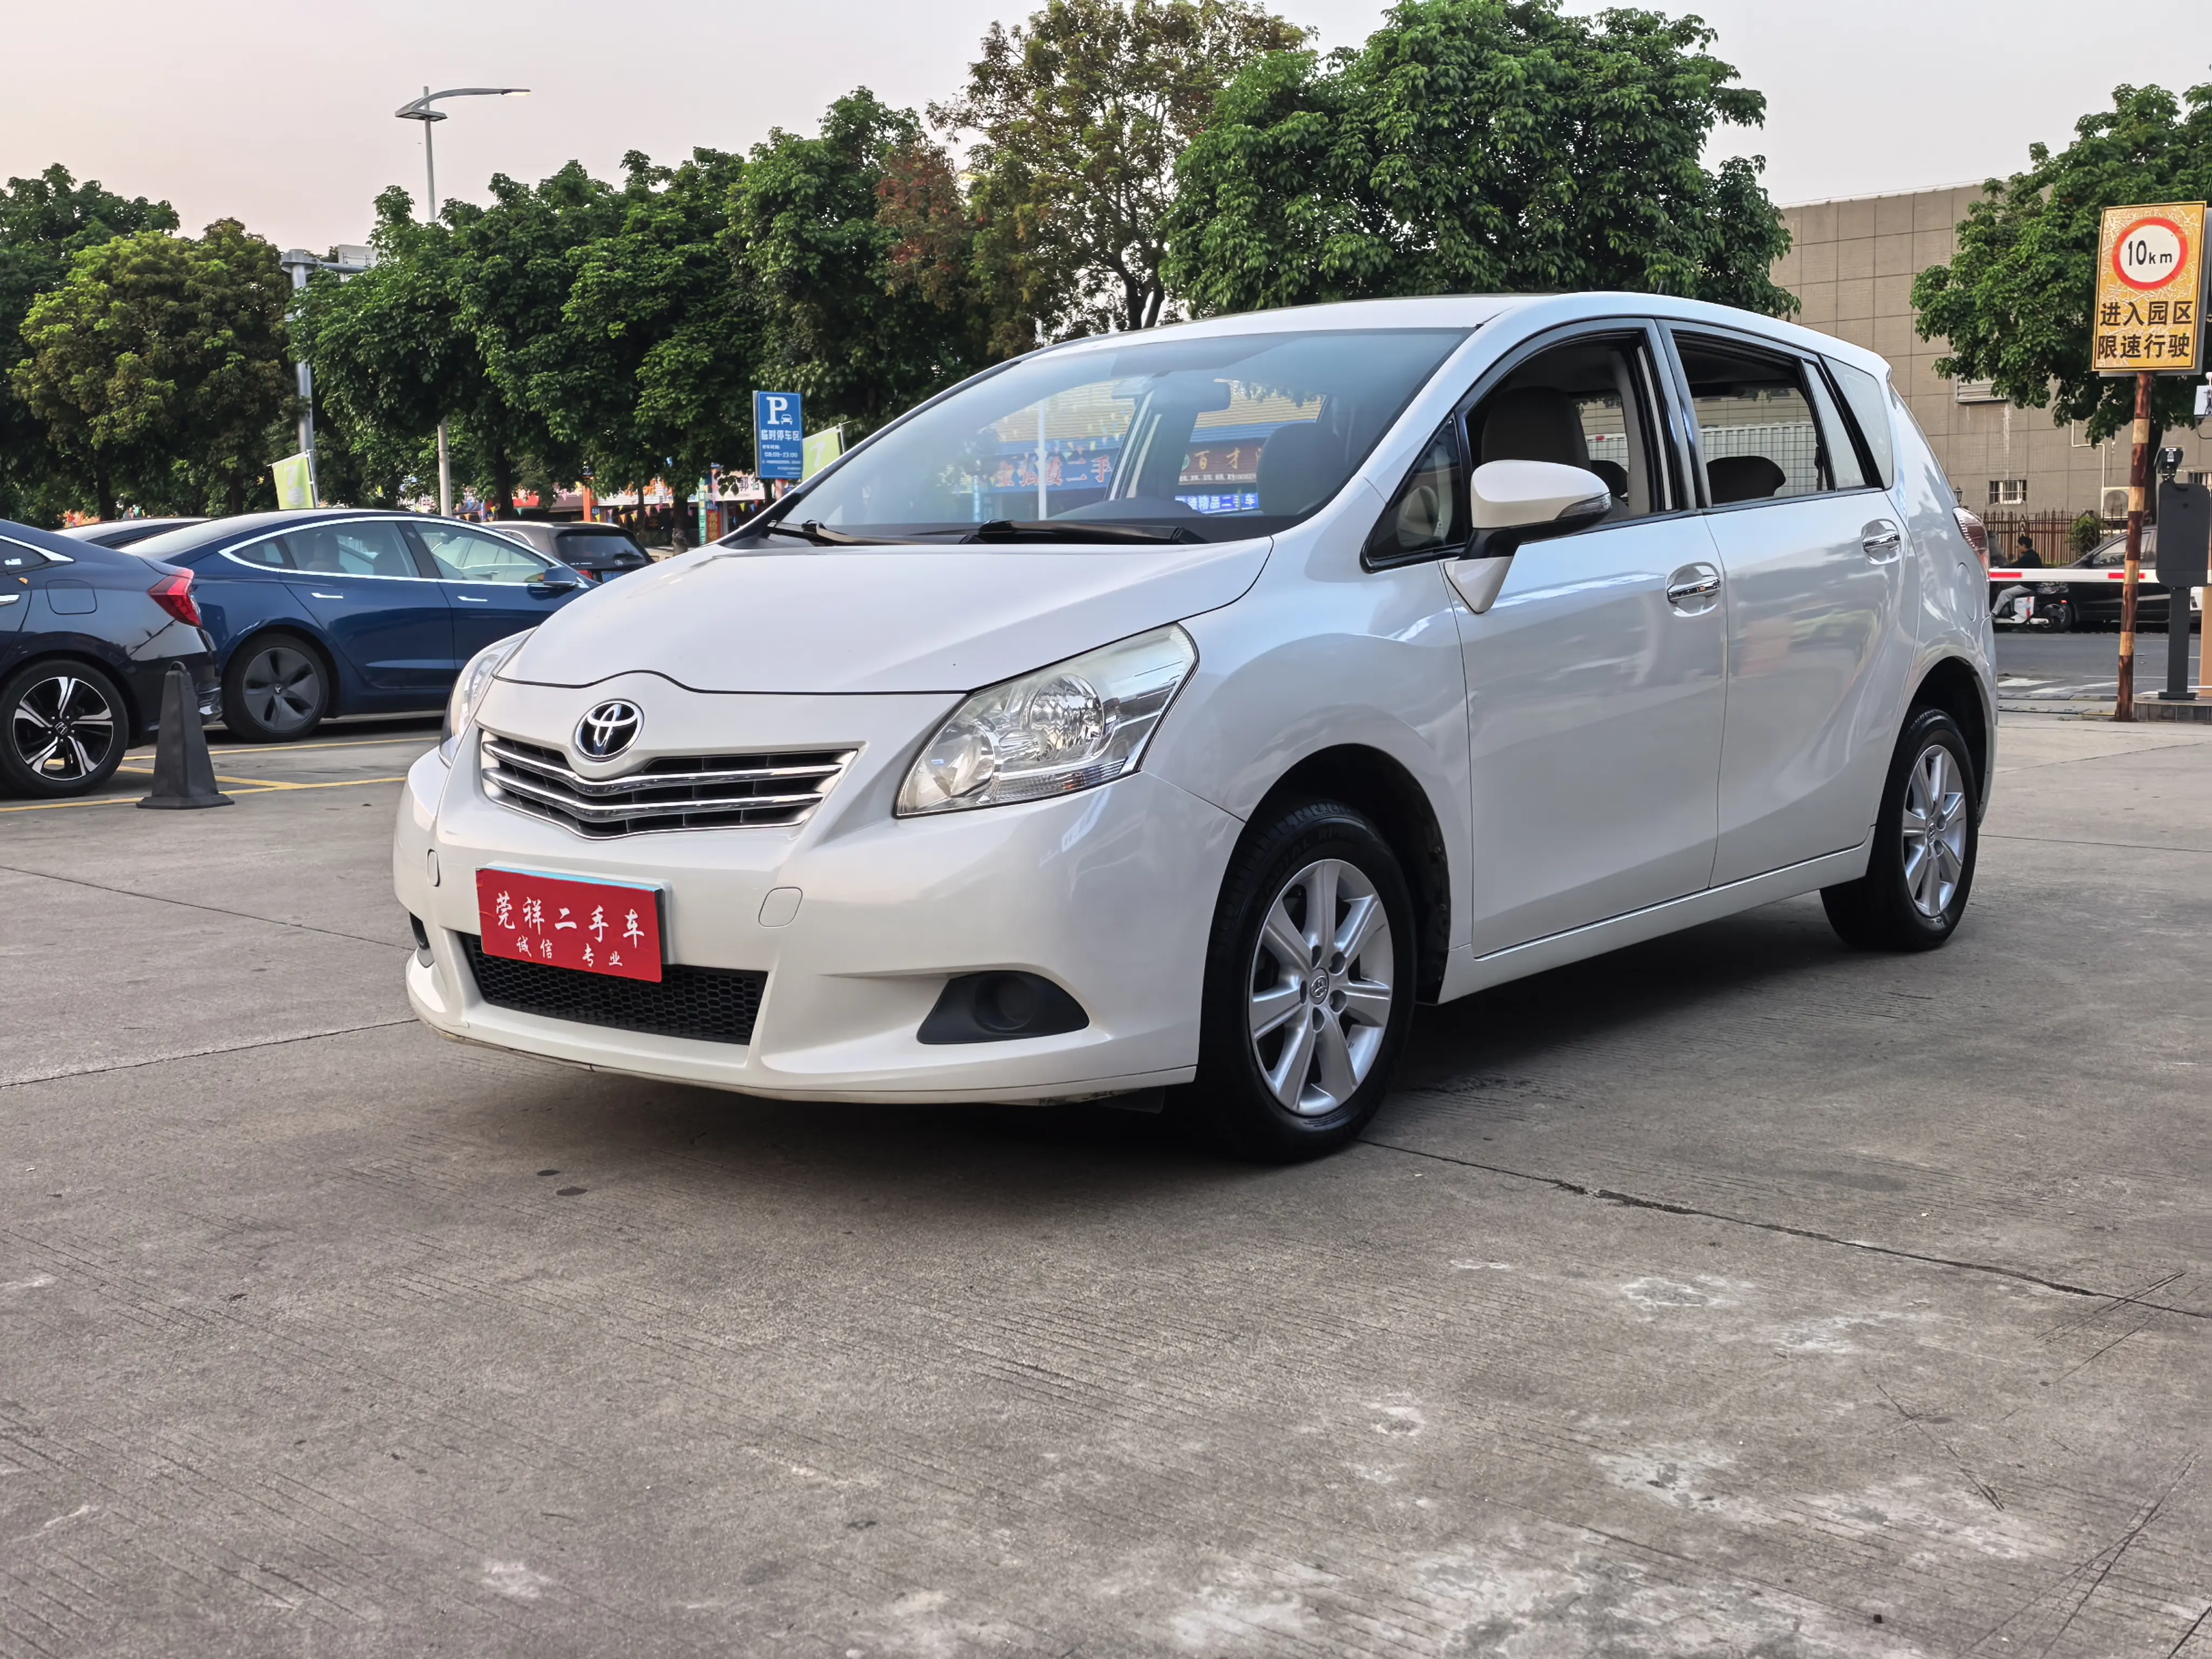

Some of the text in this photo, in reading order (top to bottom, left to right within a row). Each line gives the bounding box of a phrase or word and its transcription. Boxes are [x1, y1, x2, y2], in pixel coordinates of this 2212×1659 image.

[2128, 240, 2173, 266] 10km
[2100, 300, 2193, 327] 进入园区
[2097, 333, 2190, 360] 限速行驶
[766, 396, 788, 425] P
[761, 429, 800, 441] 临时停车区
[495, 890, 645, 948] 莞祥二手车
[516, 934, 623, 968] 诚信 专业
